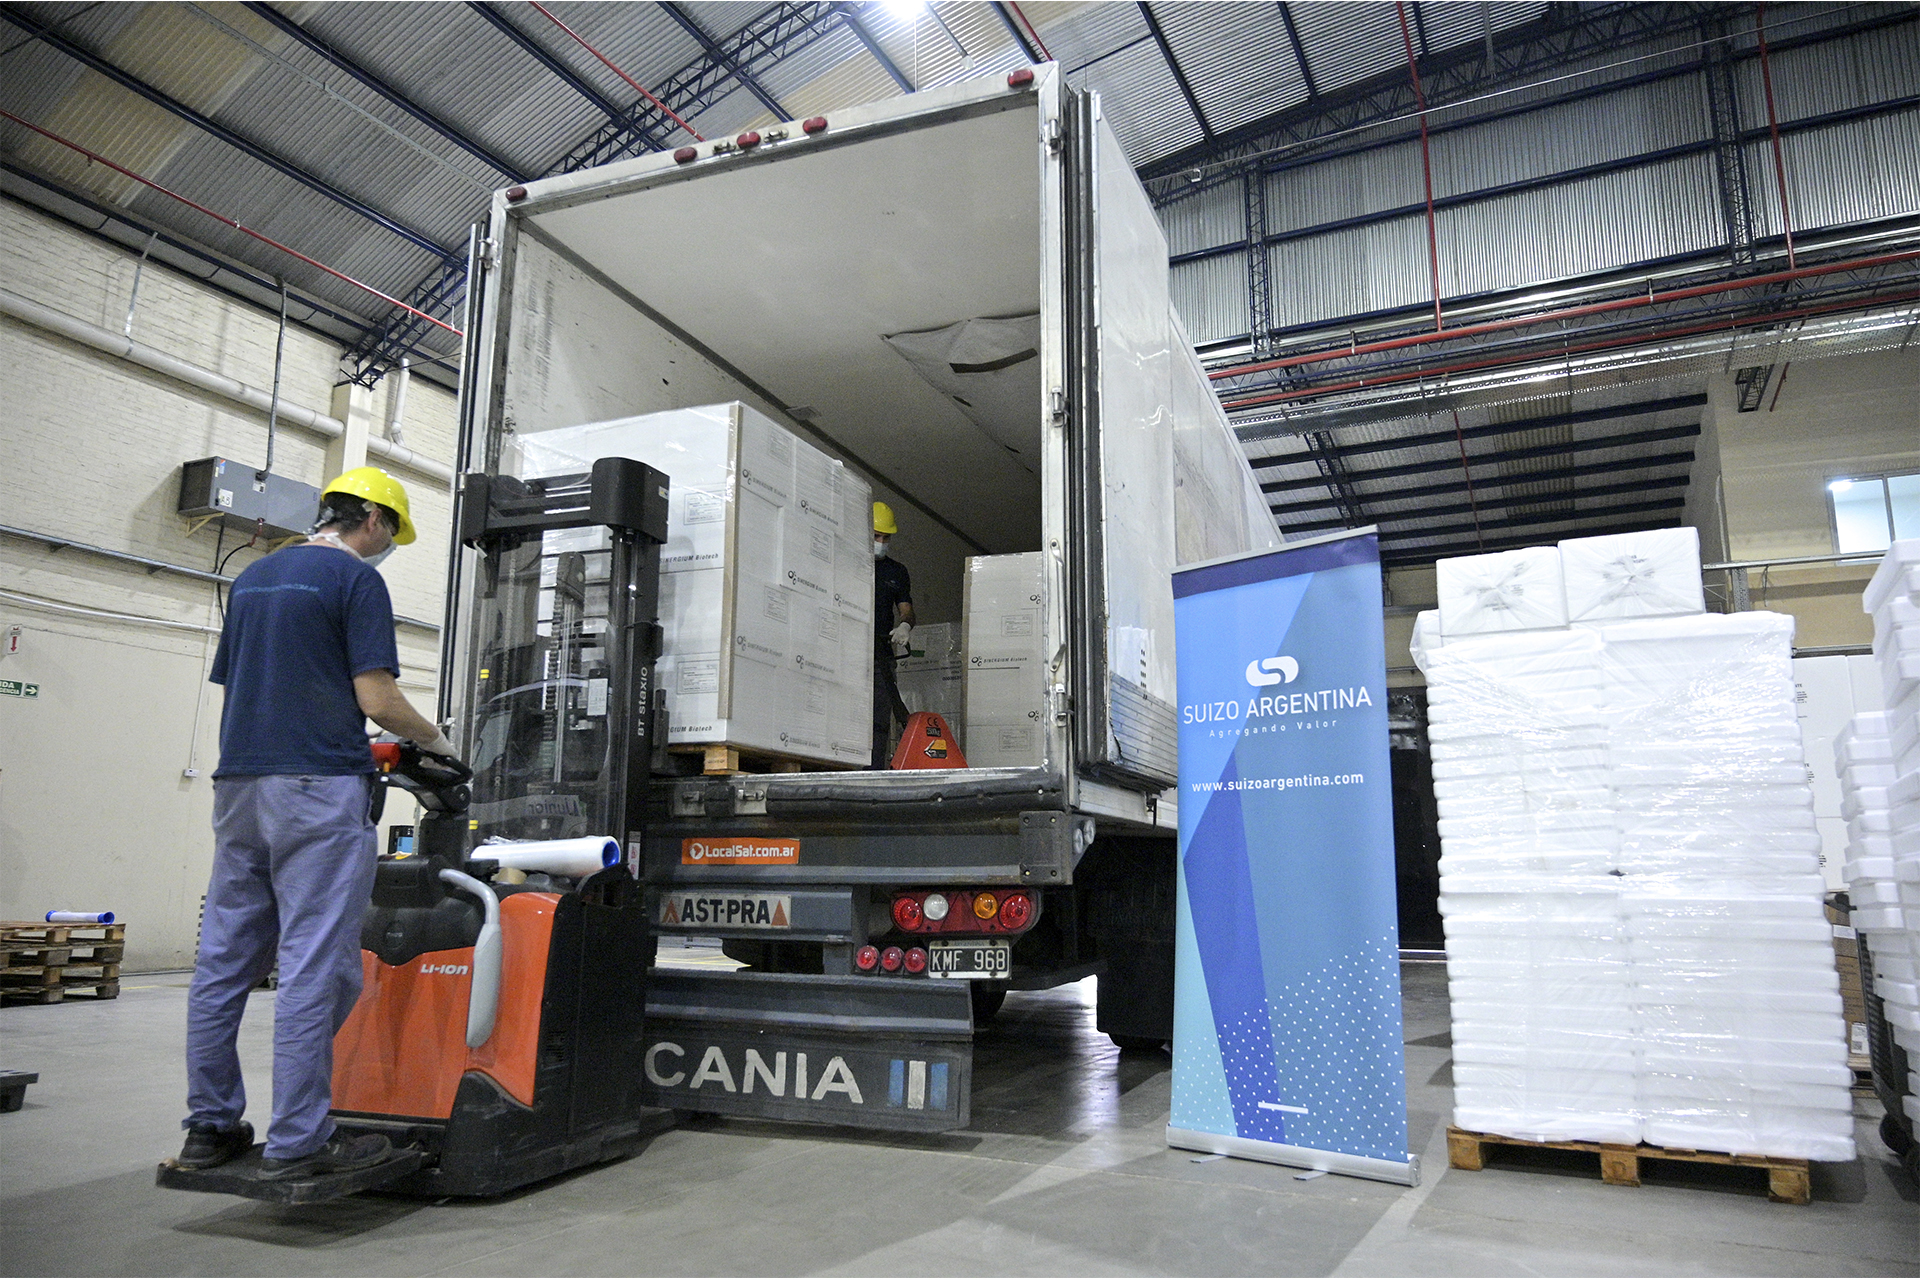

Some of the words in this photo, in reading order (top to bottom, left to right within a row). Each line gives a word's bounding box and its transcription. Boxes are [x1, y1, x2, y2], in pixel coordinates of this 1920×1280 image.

[695, 553, 719, 561] Biotech
[1183, 700, 1239, 725] SUIZO
[1245, 686, 1372, 718] ARGENTINA
[637, 718, 645, 736] BT
[1208, 724, 1286, 739] Agregando
[1296, 719, 1338, 731] Valor
[1191, 772, 1364, 792] www.suizoargentina.com
[705, 844, 795, 858] LocalSat.com.ar
[932, 950, 963, 971] KMF
[974, 949, 1006, 971] 968
[644, 1041, 863, 1104] CANIA
